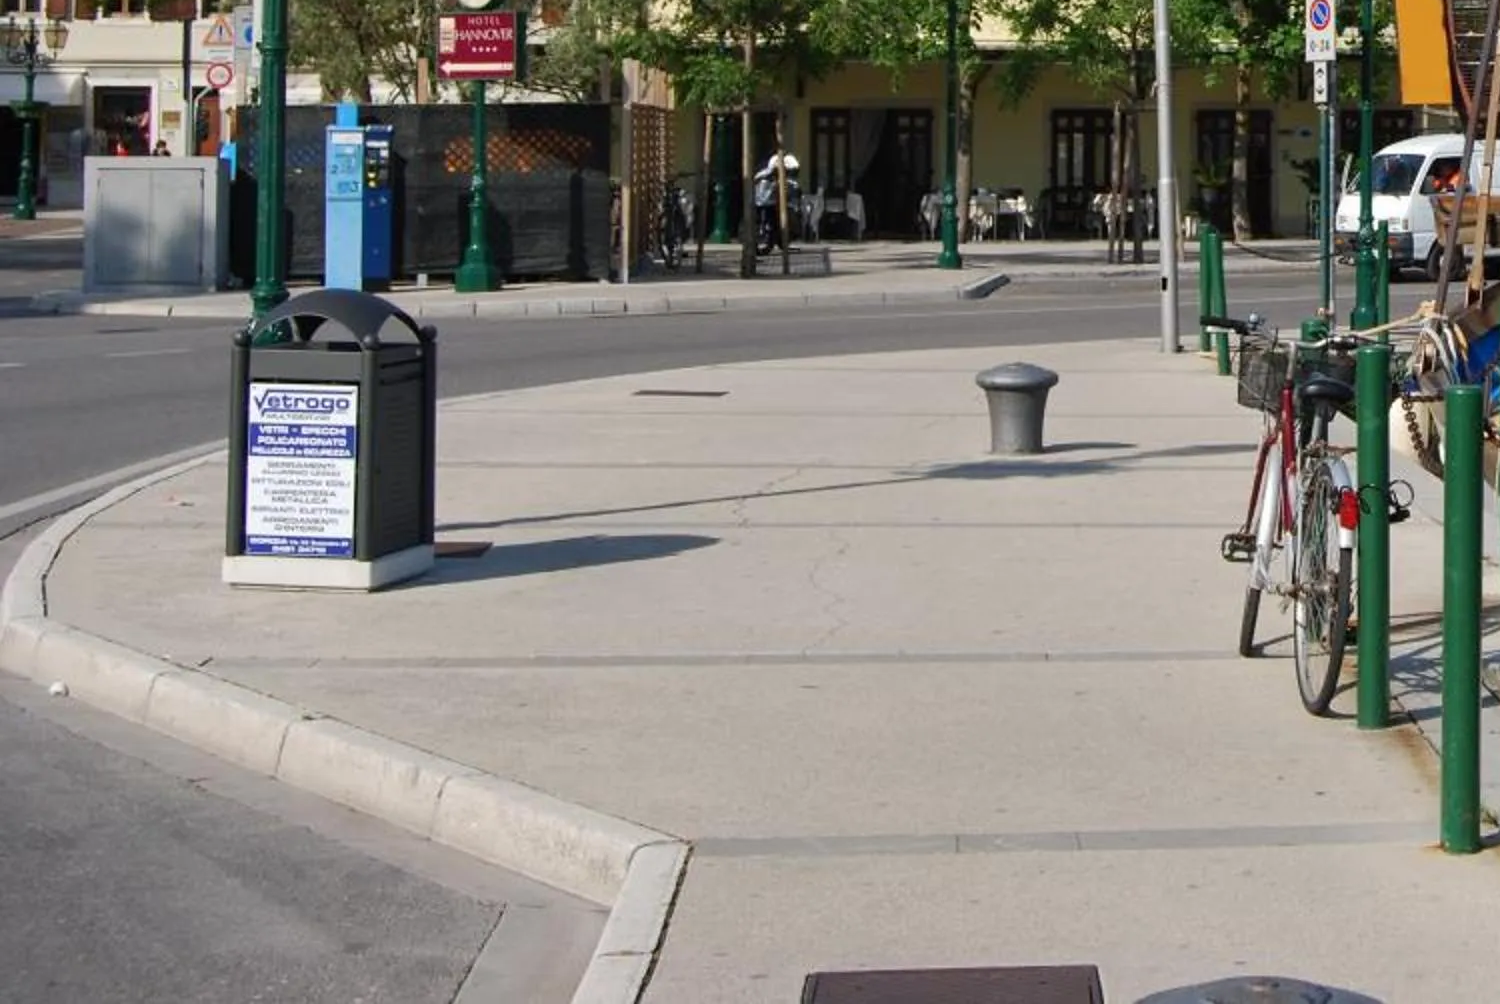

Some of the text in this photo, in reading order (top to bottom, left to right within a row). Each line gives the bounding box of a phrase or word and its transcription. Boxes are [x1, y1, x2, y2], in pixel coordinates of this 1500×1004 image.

[467, 16, 501, 26] HOTEL
[456, 28, 514, 42] HANNOVER
[253, 389, 351, 417] Vetrogo
